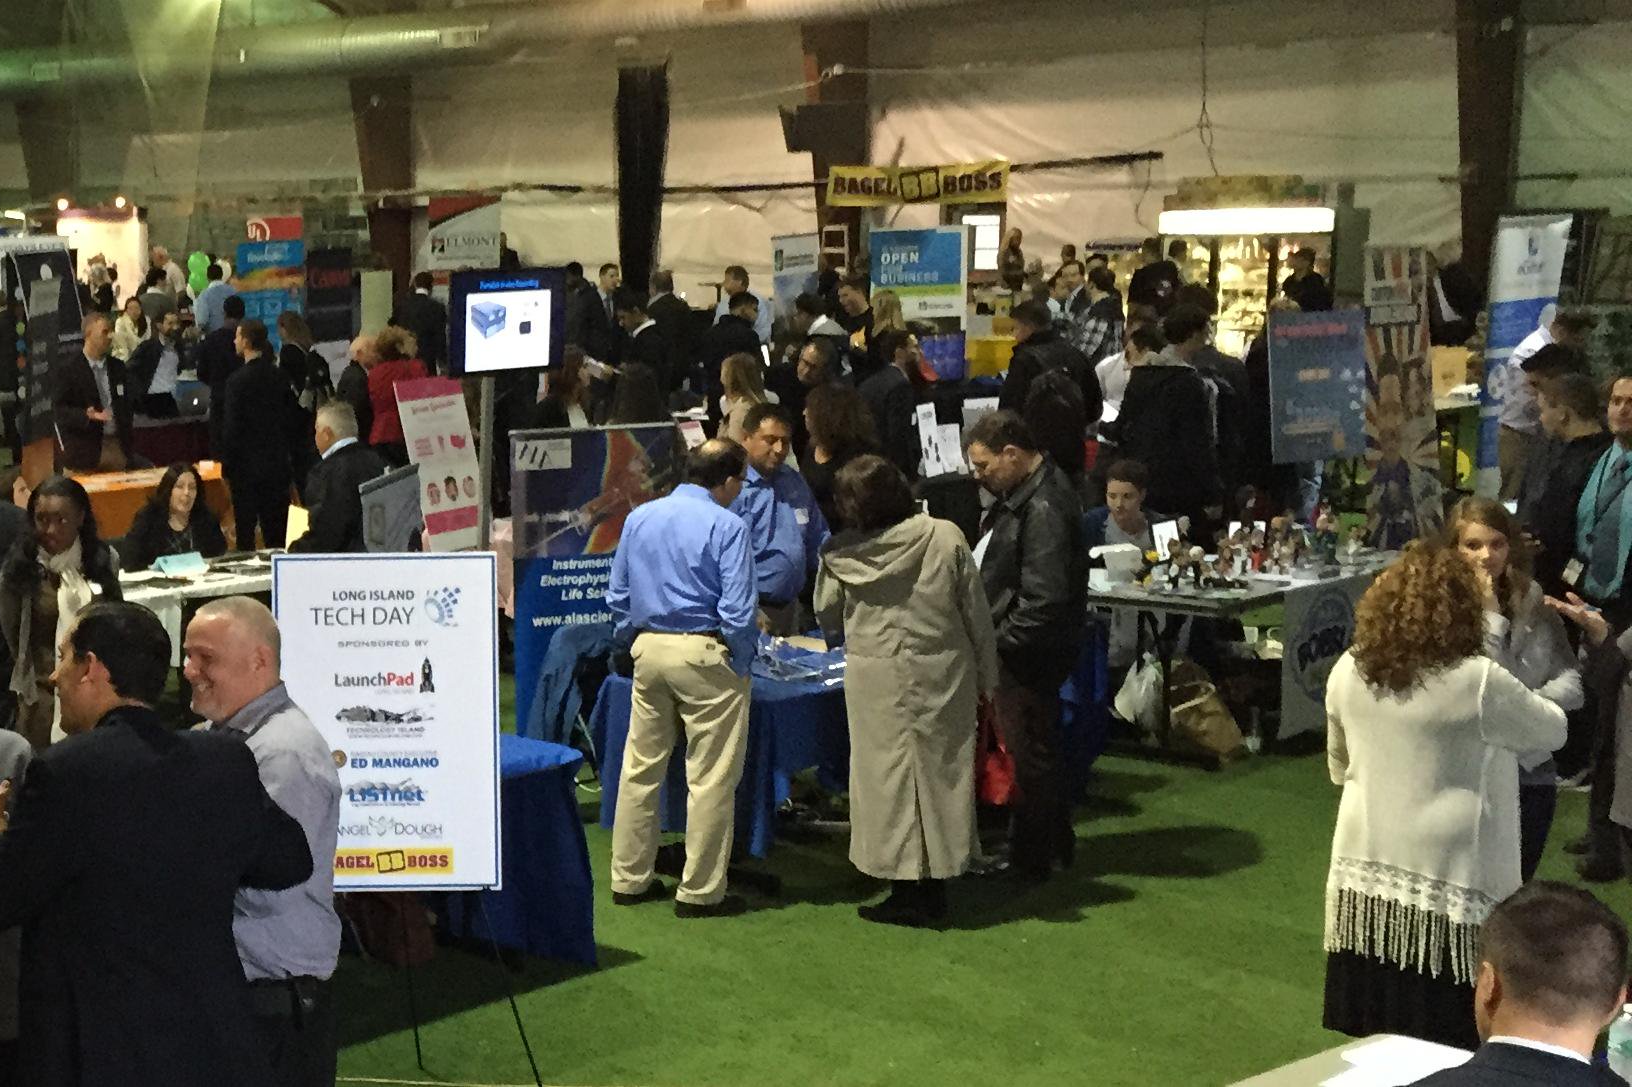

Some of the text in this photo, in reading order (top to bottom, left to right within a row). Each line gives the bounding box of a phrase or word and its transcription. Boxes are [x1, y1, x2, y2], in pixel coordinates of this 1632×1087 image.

[833, 176, 897, 196] BAGEL
[943, 172, 1002, 192] BOSS
[880, 251, 919, 265] OPEN
[552, 557, 613, 571] Instrument
[540, 572, 610, 587] Electrophysi
[332, 590, 415, 601] LONG ISLAND
[561, 587, 609, 601] Life Scie
[310, 607, 415, 626] TECH DAY
[337, 640, 410, 649] SPONSORED
[334, 672, 415, 688] LaunchPad
[351, 757, 440, 769] ED MANGANO
[395, 822, 443, 836] DOUGH
[334, 855, 449, 869] AGEL BOSS
